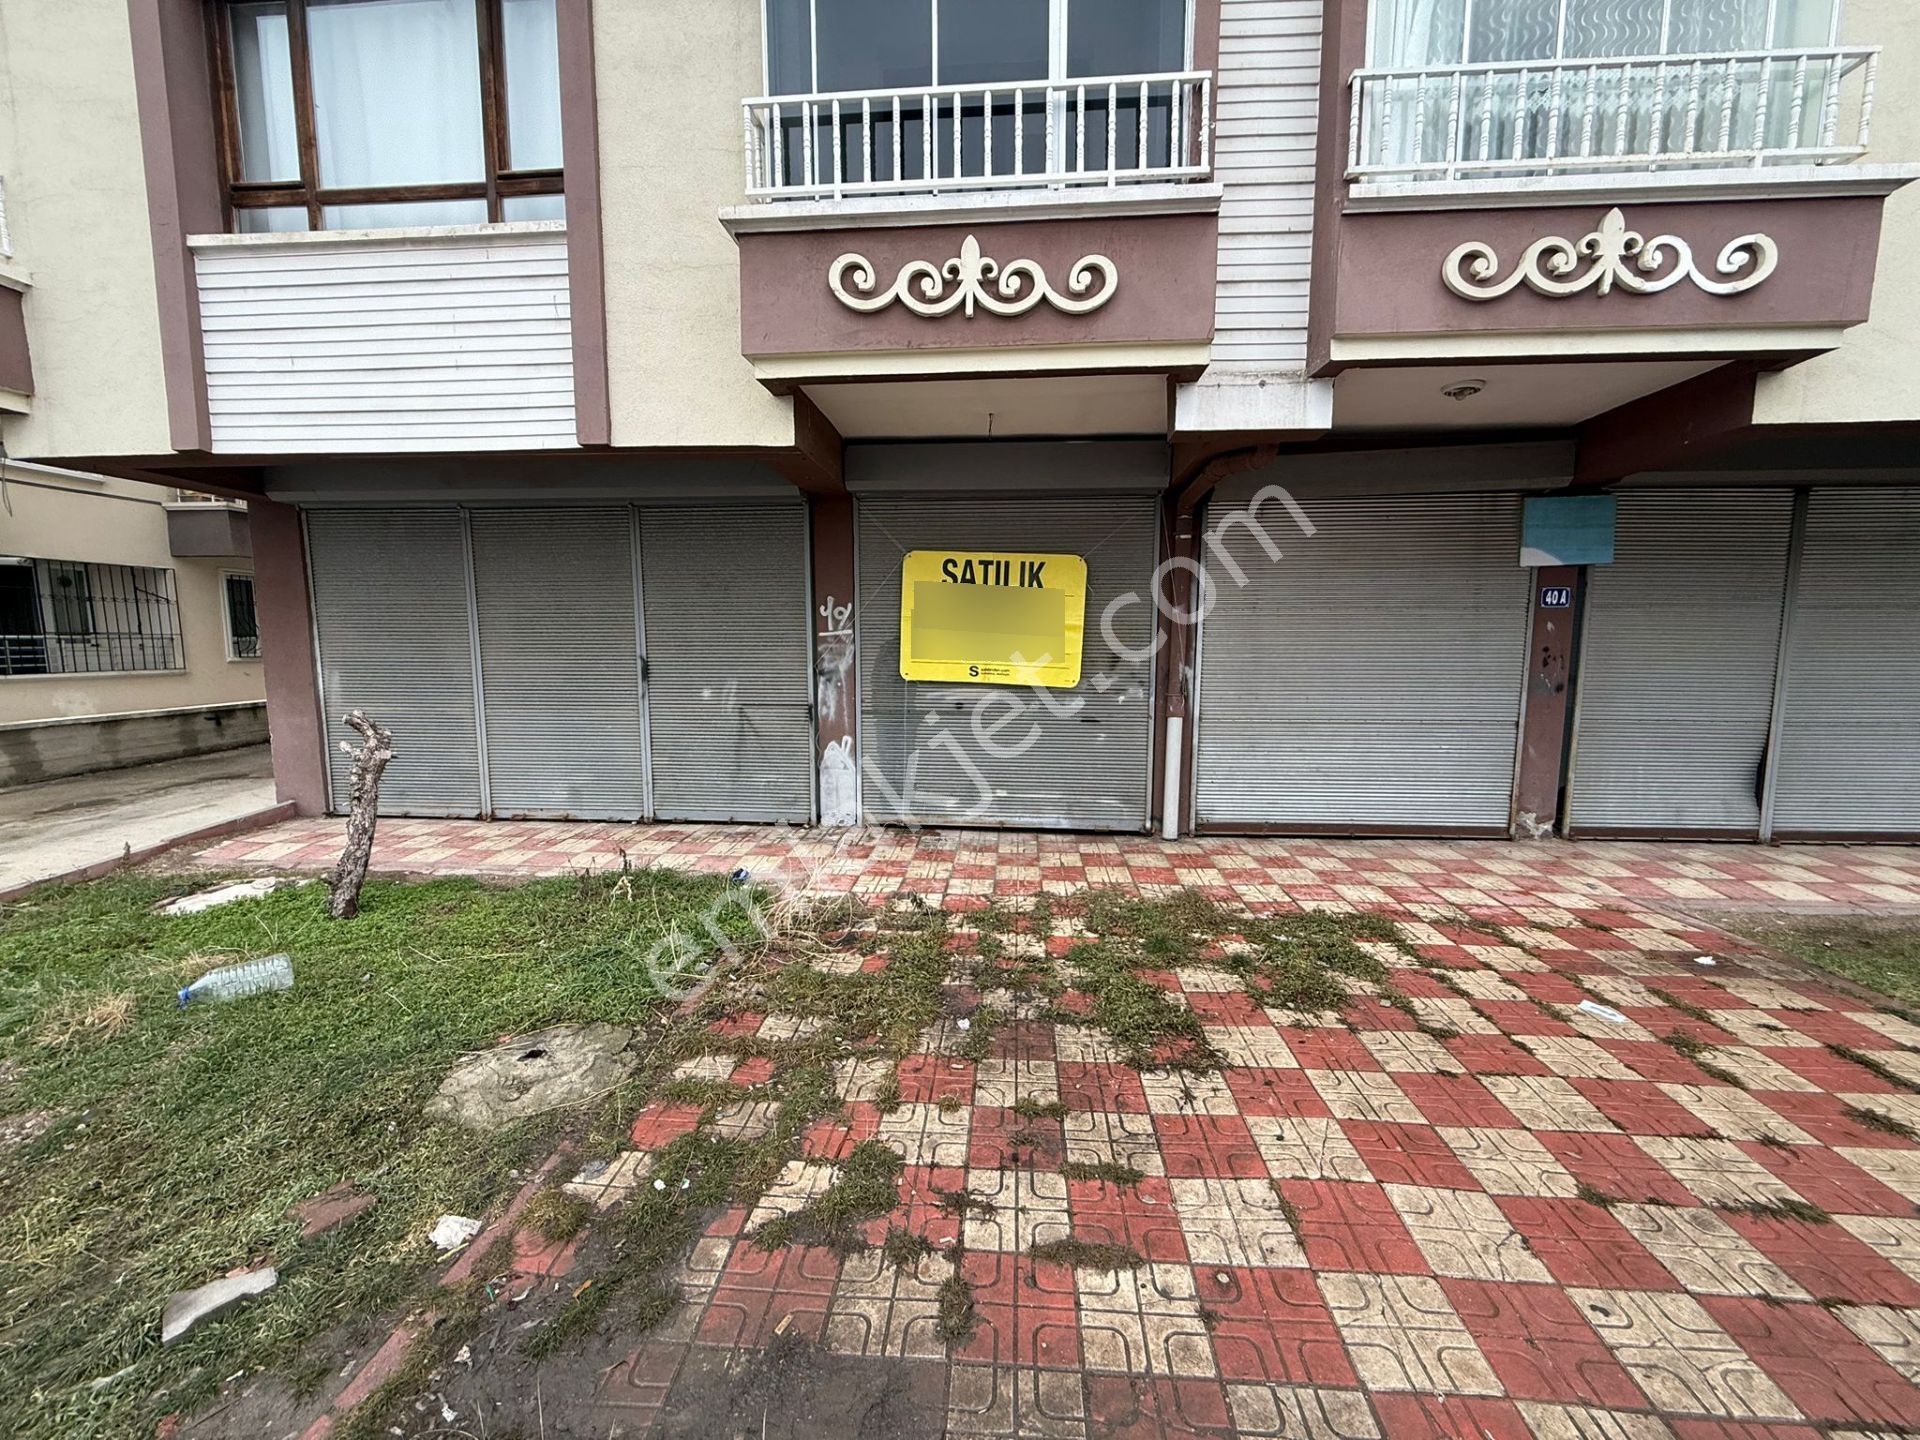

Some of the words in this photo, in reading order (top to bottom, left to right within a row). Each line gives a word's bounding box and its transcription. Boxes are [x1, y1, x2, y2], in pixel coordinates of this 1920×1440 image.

[942, 558, 1046, 588] SATILIK
[1546, 590, 1558, 605] 40
[1559, 590, 1567, 604] A
